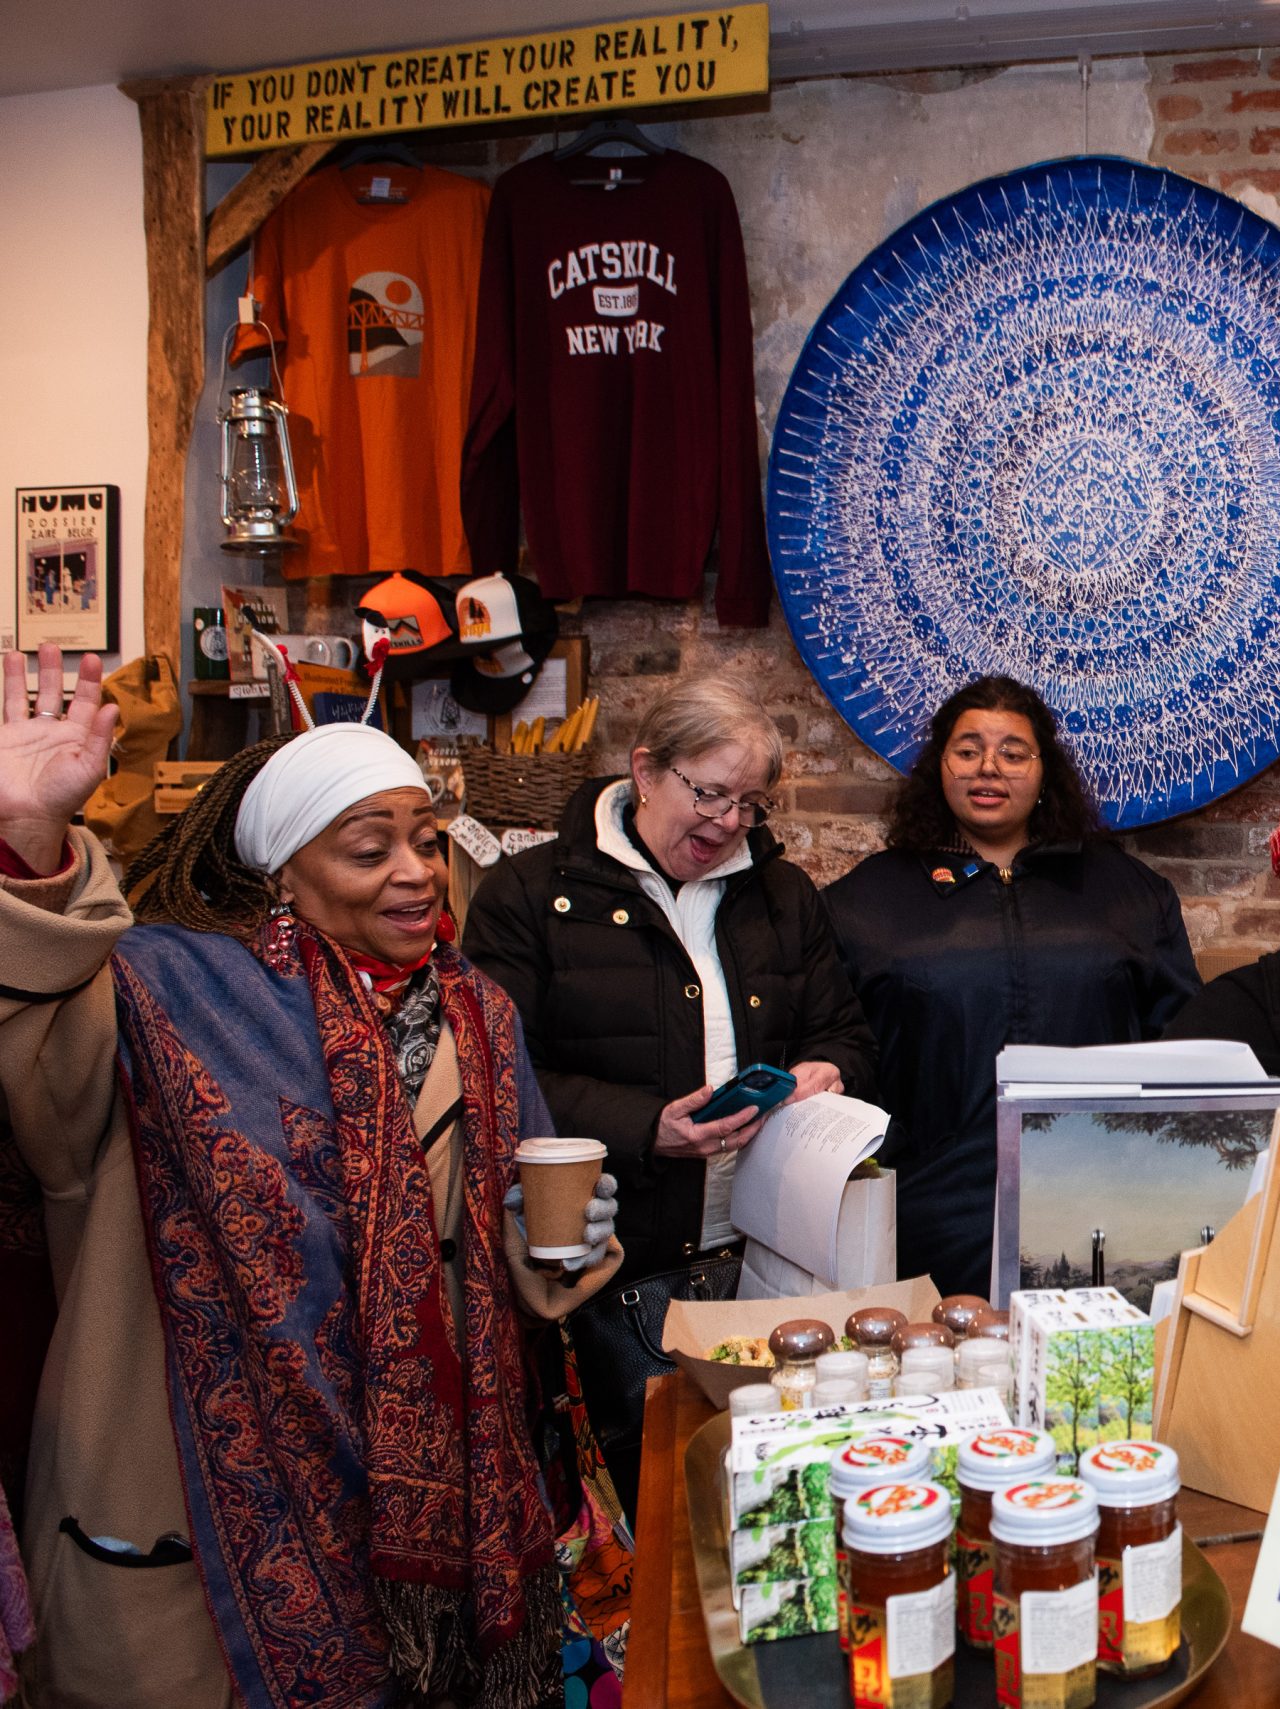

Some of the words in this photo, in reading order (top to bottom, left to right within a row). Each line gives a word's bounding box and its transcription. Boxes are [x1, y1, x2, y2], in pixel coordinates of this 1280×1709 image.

[213, 82, 233, 110] IF
[248, 74, 294, 106] YOU
[308, 60, 376, 98] DON'T
[385, 50, 490, 89] CREATE
[502, 39, 575, 74] YOUR
[595, 15, 738, 62] REALITY,
[224, 111, 290, 144] YOUR
[306, 93, 428, 135] REALITY
[442, 84, 511, 118] WILL
[524, 69, 636, 111] CREATE
[656, 60, 716, 95] YOU
[548, 240, 677, 299] CATSKILL
[565, 325, 620, 356] NEW
[28, 516, 97, 528] DOSSIER
